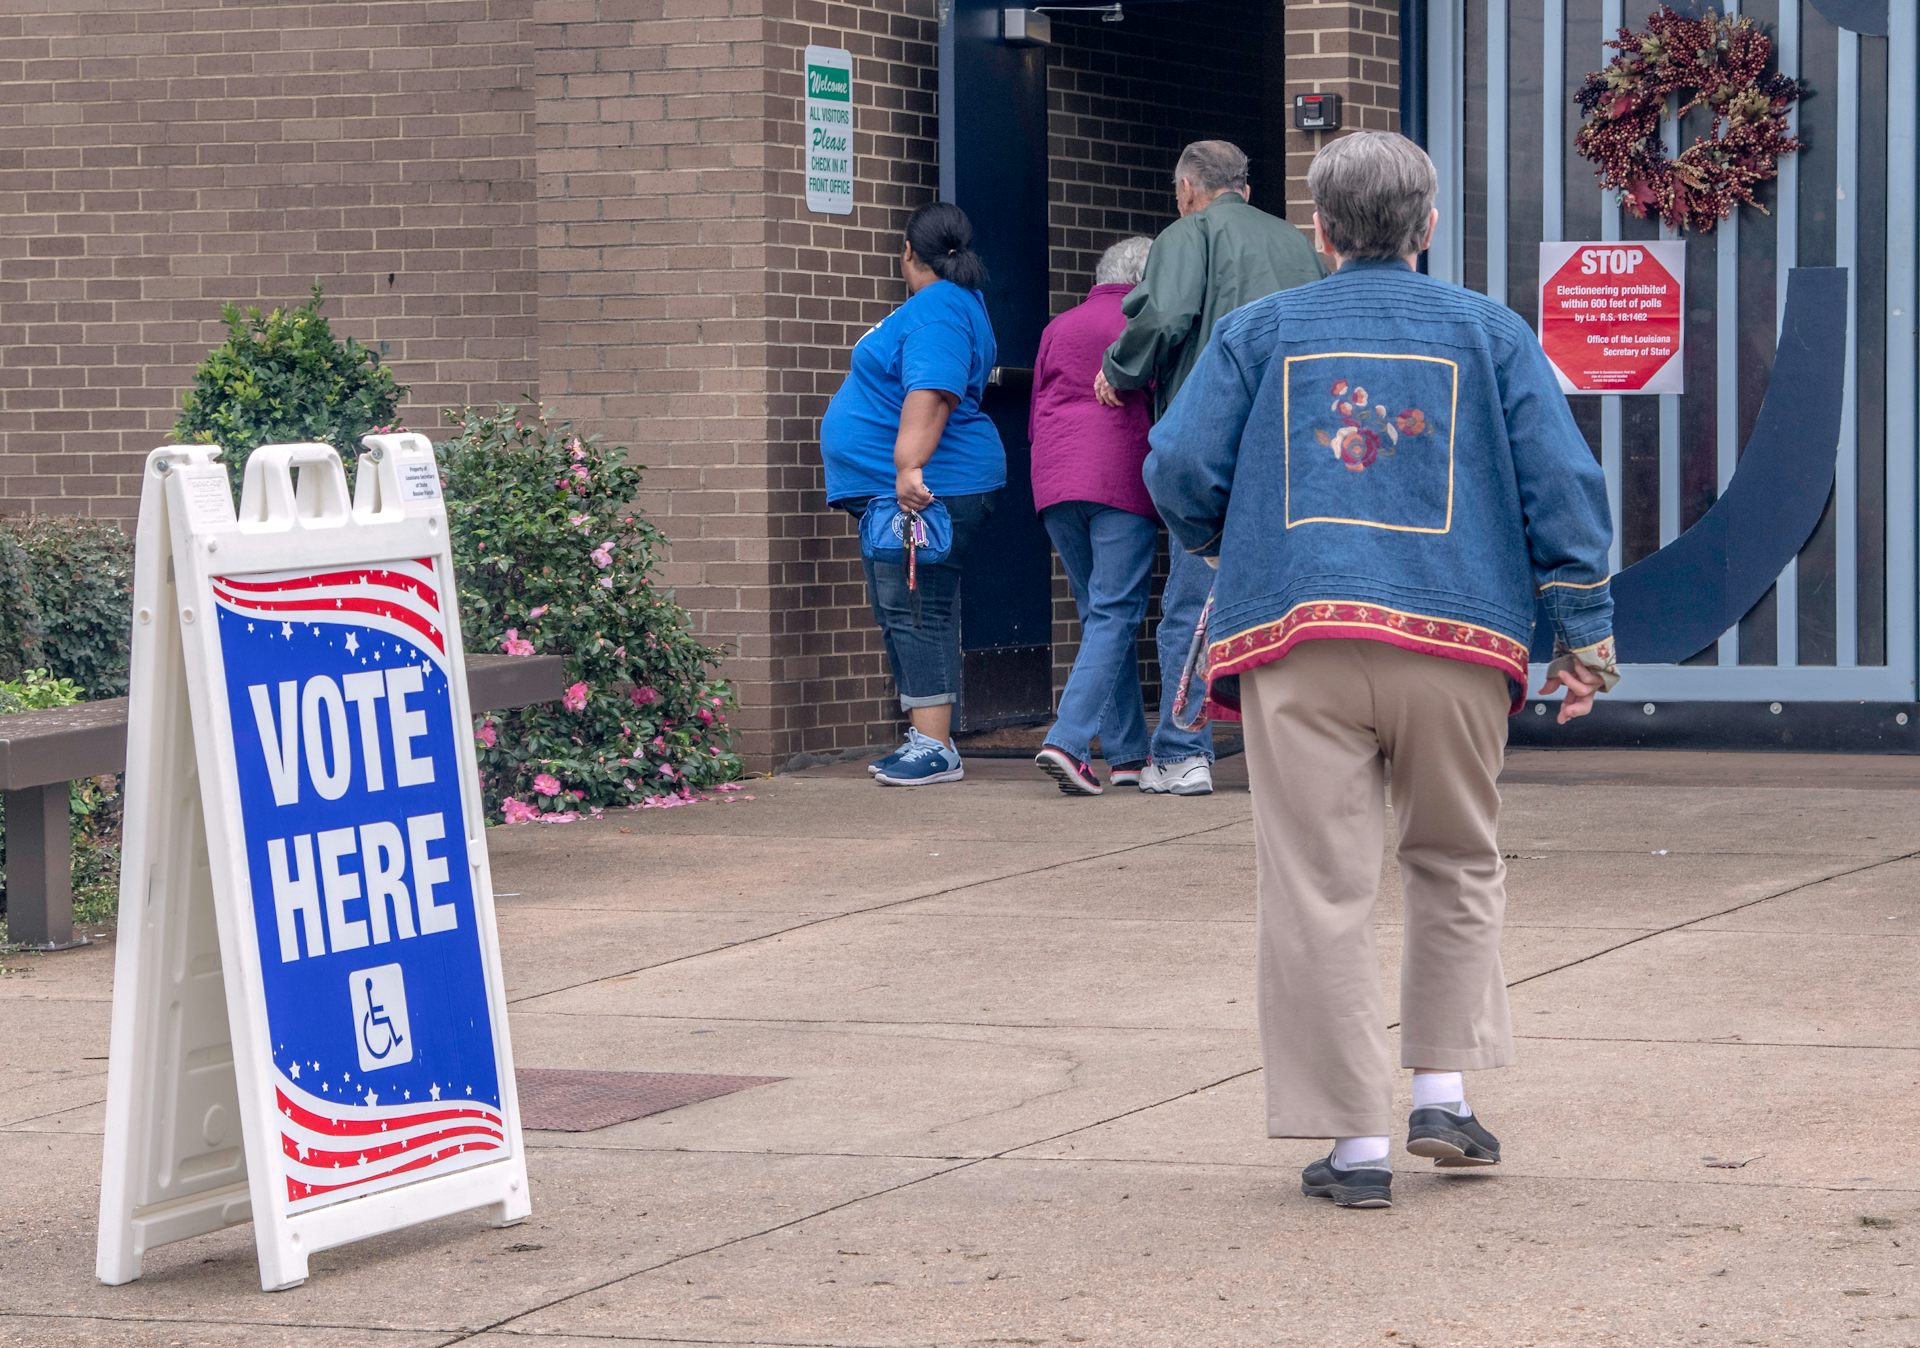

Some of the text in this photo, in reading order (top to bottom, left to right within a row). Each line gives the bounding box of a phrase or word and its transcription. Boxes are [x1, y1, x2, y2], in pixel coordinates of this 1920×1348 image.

[810, 70, 848, 94] Welcome
[810, 106, 848, 124] ALL VISITORS
[813, 128, 846, 152] Please
[812, 156, 848, 173] CHECK IN AT
[809, 177, 850, 194] FRONT OFFICE
[1581, 249, 1644, 274] STOP
[1557, 284, 1666, 297] Electioneering prohibited
[1561, 298, 1662, 310] within 600 feet of polls
[1574, 313, 1648, 323] by La. R.S. 18:1462
[1587, 334, 1670, 344] Office of the Louisiana
[1603, 347, 1670, 357] Secretary of State
[248, 666, 435, 807] VOTE
[268, 812, 458, 964] HERE
